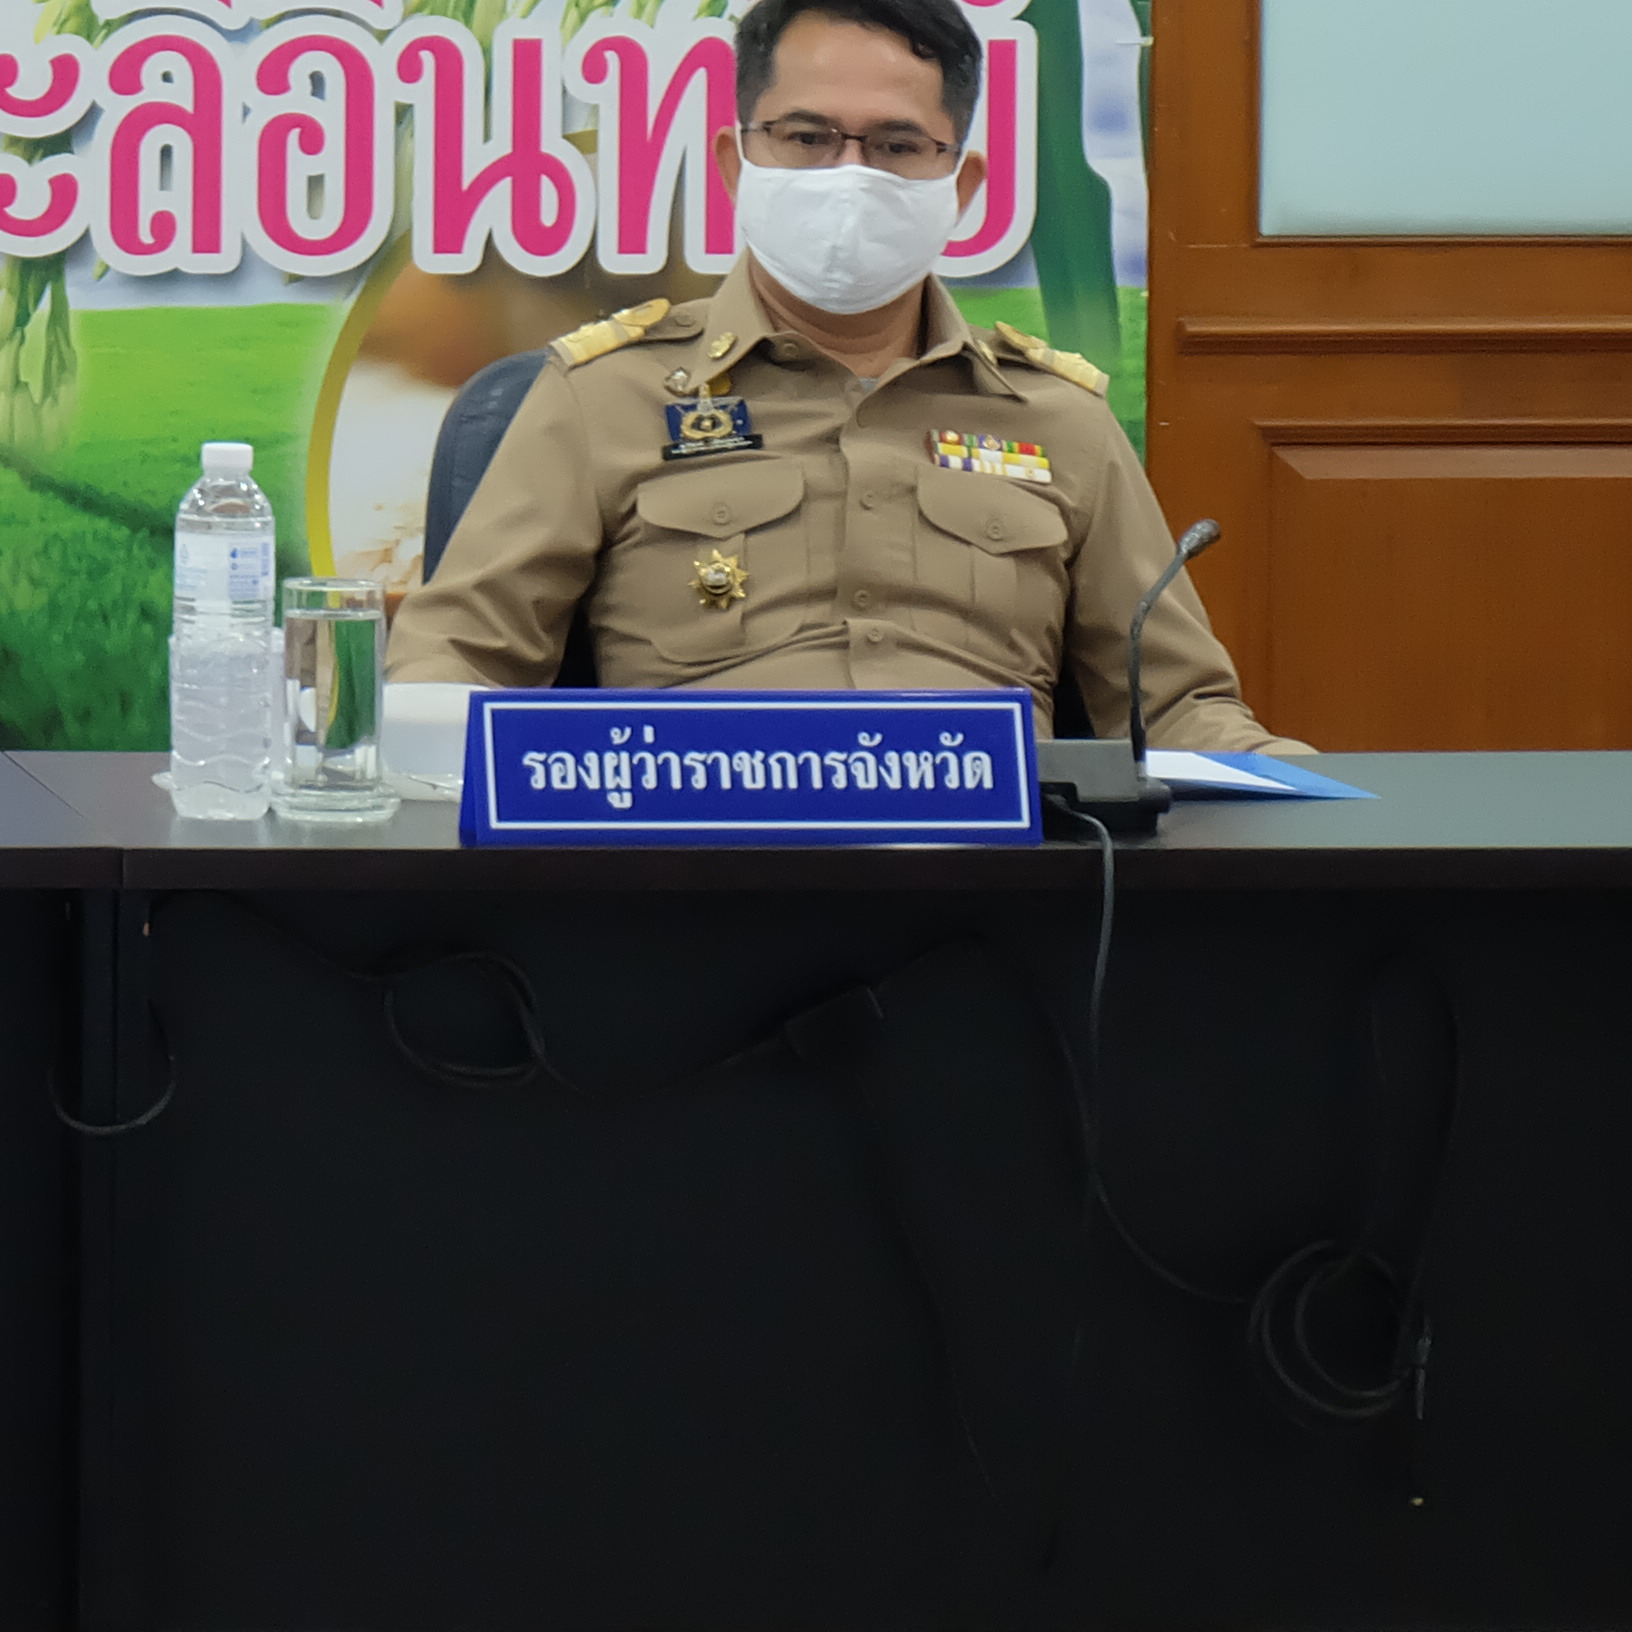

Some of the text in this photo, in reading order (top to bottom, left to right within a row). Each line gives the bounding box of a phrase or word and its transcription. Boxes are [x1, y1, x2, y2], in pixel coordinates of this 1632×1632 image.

[521, 724, 995, 809] รองผู้ว่าราชการจังหวัด
